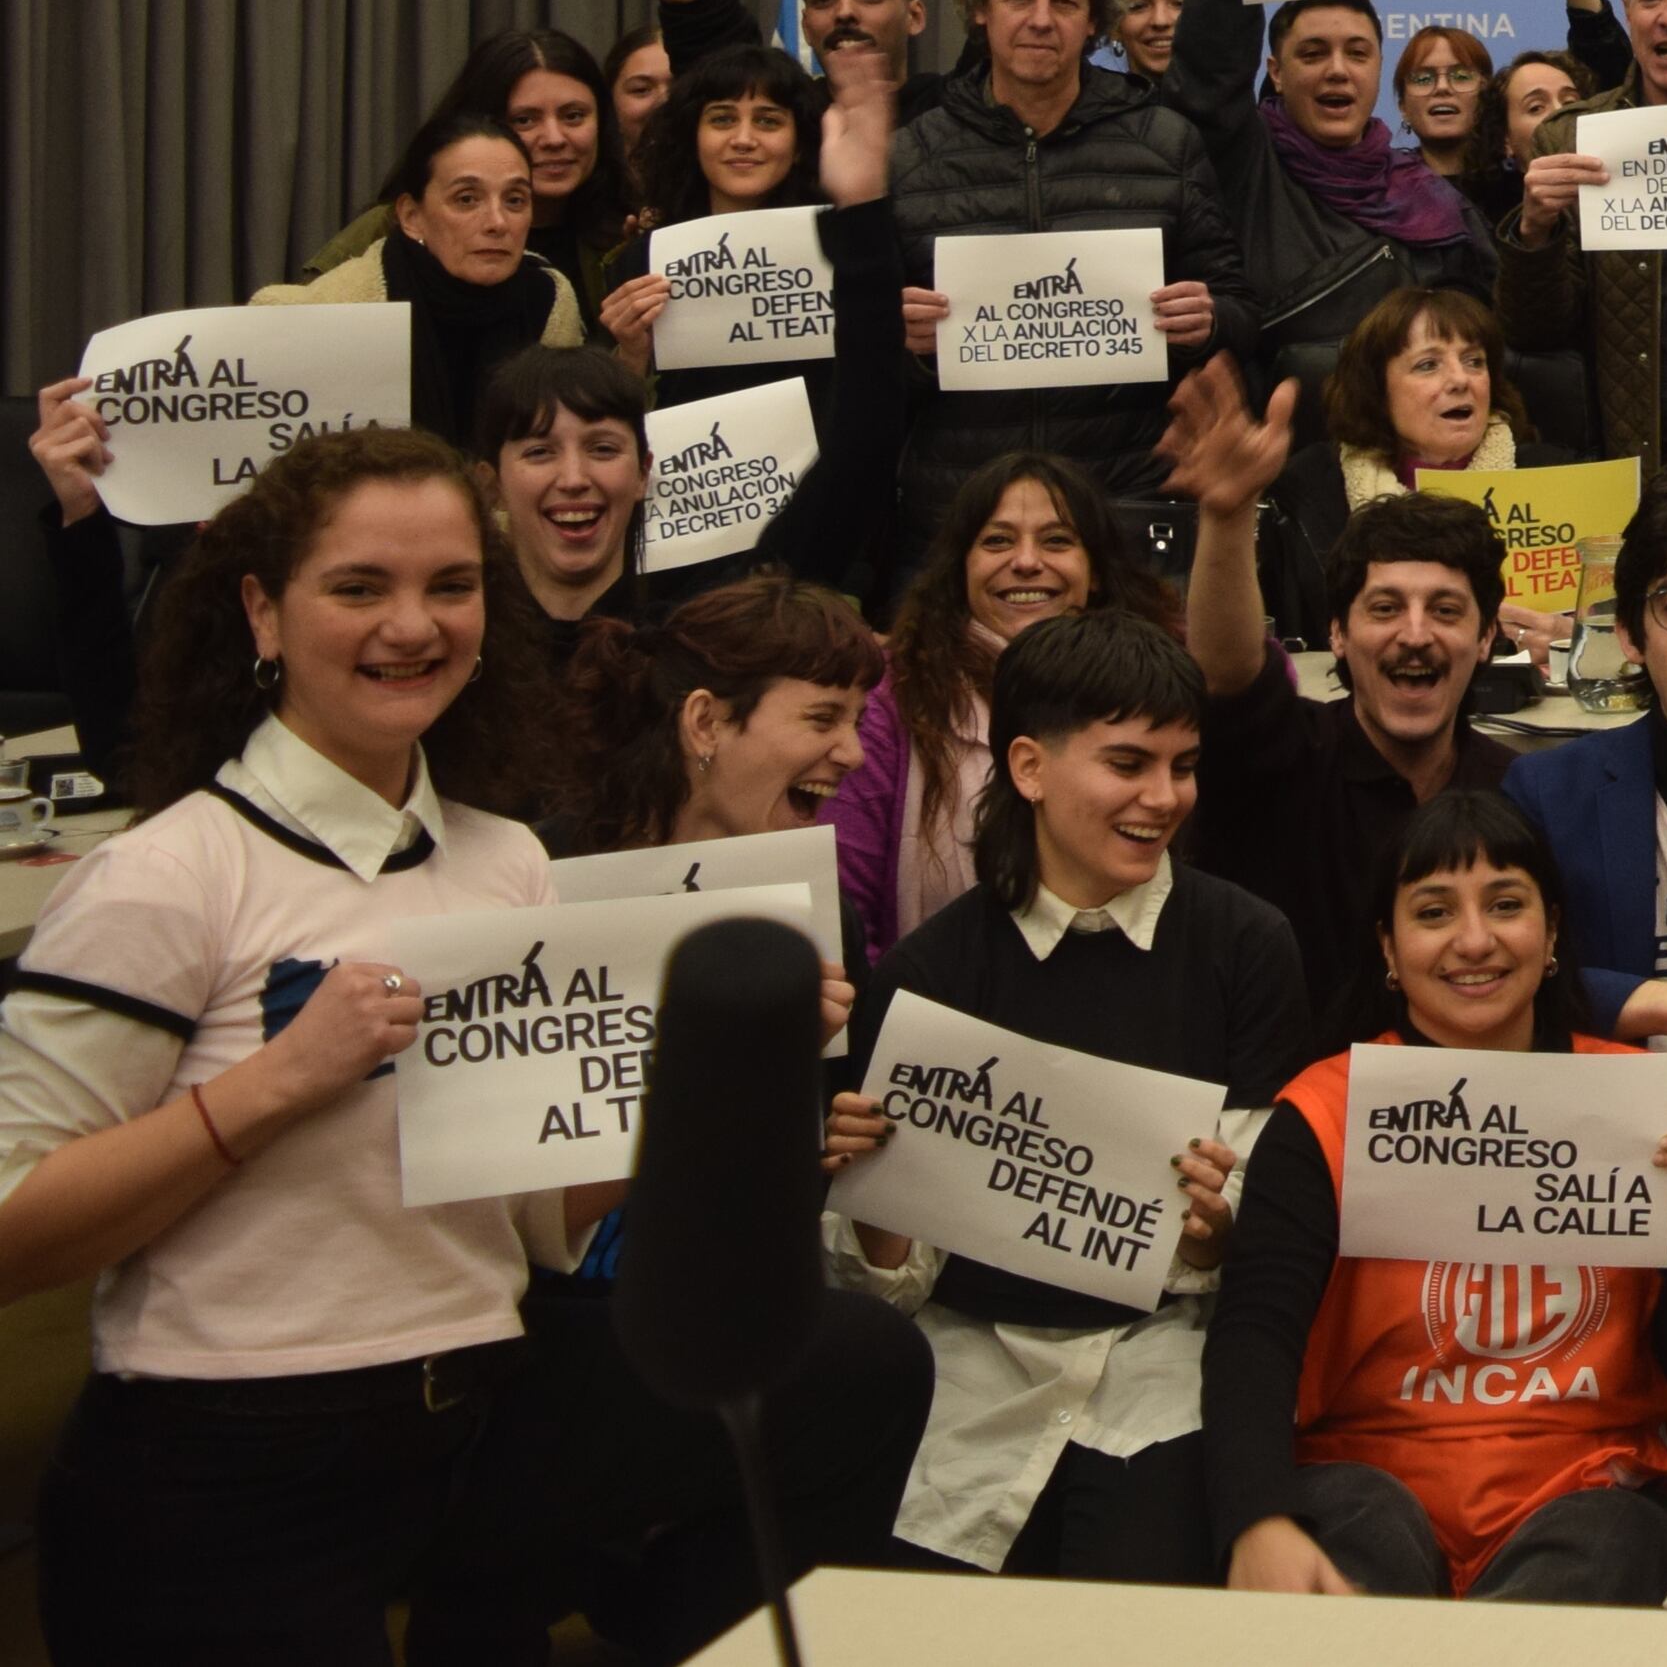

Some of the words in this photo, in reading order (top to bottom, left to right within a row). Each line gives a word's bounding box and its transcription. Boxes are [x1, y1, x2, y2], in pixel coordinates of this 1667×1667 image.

[665, 232, 736, 277] ENTRÁ
[743, 247, 776, 269] AL
[95, 335, 199, 394] ENTRÁ
[208, 358, 258, 388] AL
[422, 941, 553, 1024] ENTRÁ
[563, 966, 624, 1006] AL
[889, 1056, 999, 1111] ENTRÁ
[1000, 1091, 1049, 1129] AL
[1369, 1078, 1471, 1132] ENTRÁ
[1480, 1104, 1528, 1134] AL
[883, 1090, 1094, 1176] CONGRESO
[1368, 1134, 1577, 1168] CONGRESO
[987, 1159, 1163, 1238] DEFENDÉ
[1534, 1167, 1620, 1203] SALÍ
[1624, 1175, 1652, 1204] A
[1021, 1212, 1072, 1252] AL
[1081, 1227, 1150, 1271] INT
[1478, 1205, 1524, 1233] LA
[1534, 1207, 1651, 1236] CALLE
[1400, 1364, 1600, 1405] INCAA
